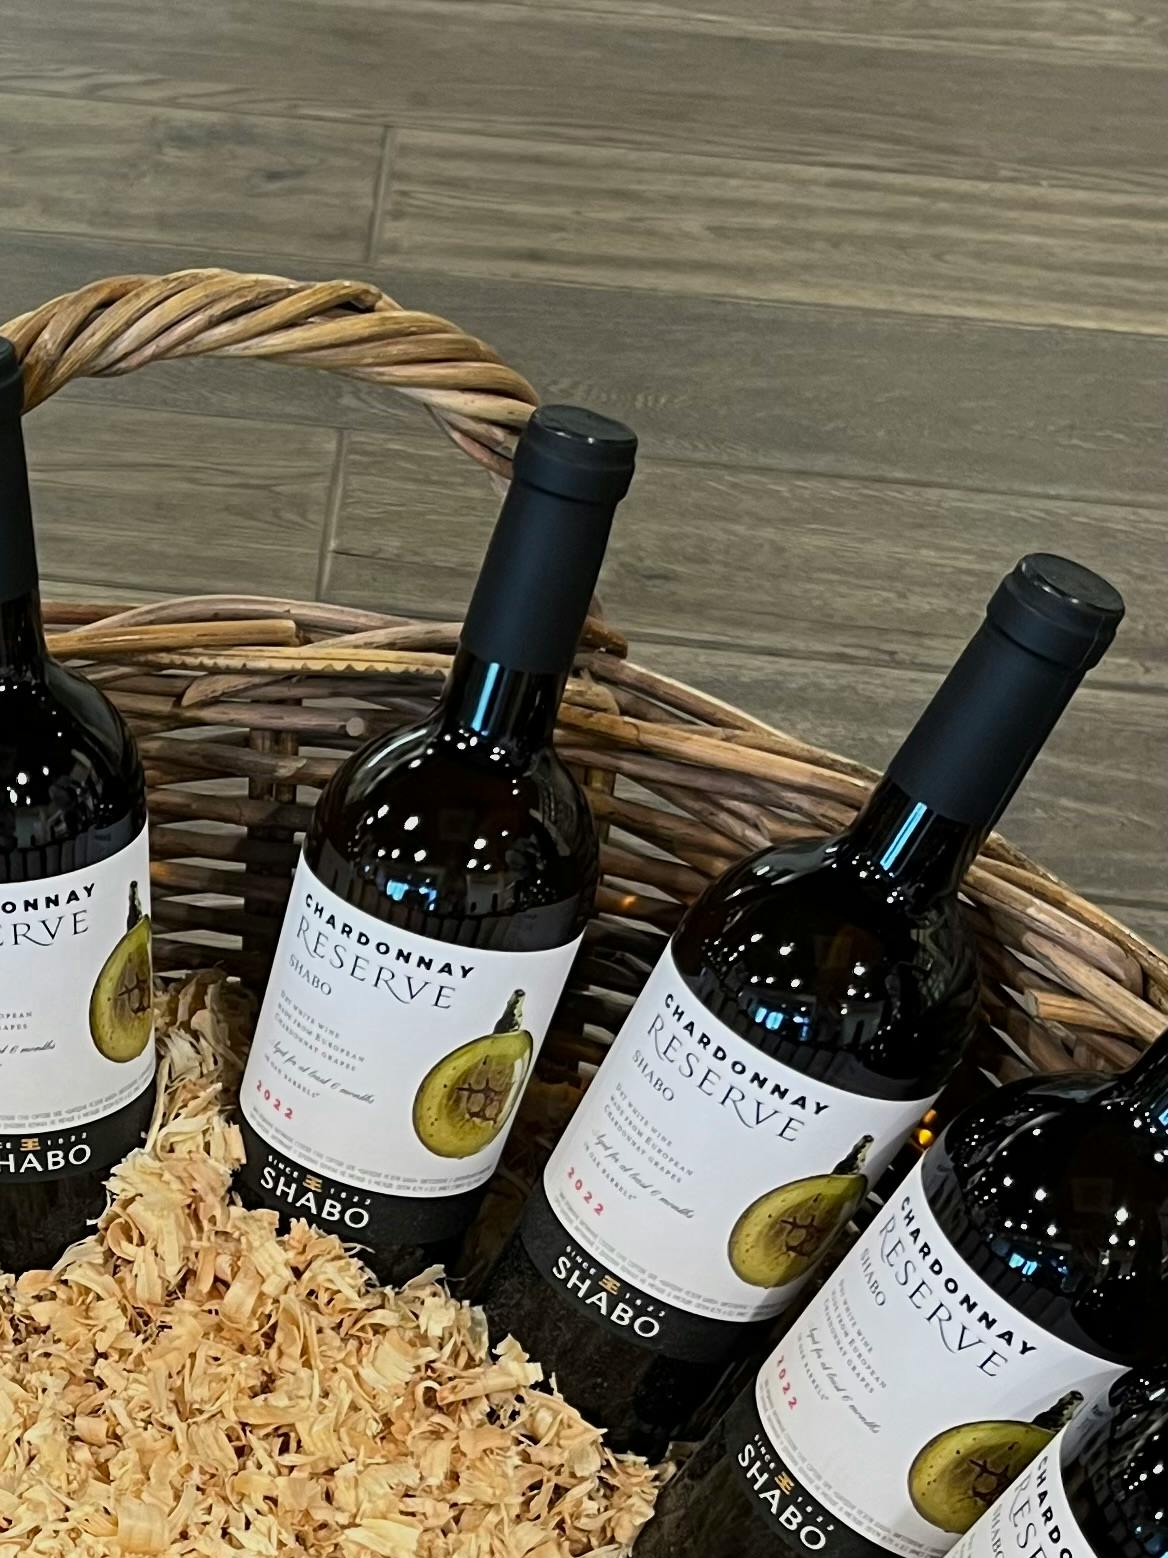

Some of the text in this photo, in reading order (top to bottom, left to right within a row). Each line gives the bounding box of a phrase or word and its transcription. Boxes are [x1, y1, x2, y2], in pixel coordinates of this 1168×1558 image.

[289, 954, 332, 996] SHABO
[296, 914, 457, 1010] RESERVE
[305, 893, 475, 980] CHARDONNAY
[632, 1049, 674, 1101] SHABO
[646, 1012, 806, 1143] RESERVE
[664, 993, 831, 1117] CHARDONNAY
[256, 1080, 293, 1120] 2022
[260, 1167, 369, 1229] SHABO
[567, 1166, 604, 1216] 2022
[552, 1255, 660, 1338] SHABO
[860, 1248, 887, 1306] SHABO
[879, 1215, 1009, 1377] RESERVE
[901, 1196, 1037, 1355] CHARDONNAY
[777, 1355, 797, 1410] 2022
[737, 1443, 826, 1550] SHABO
